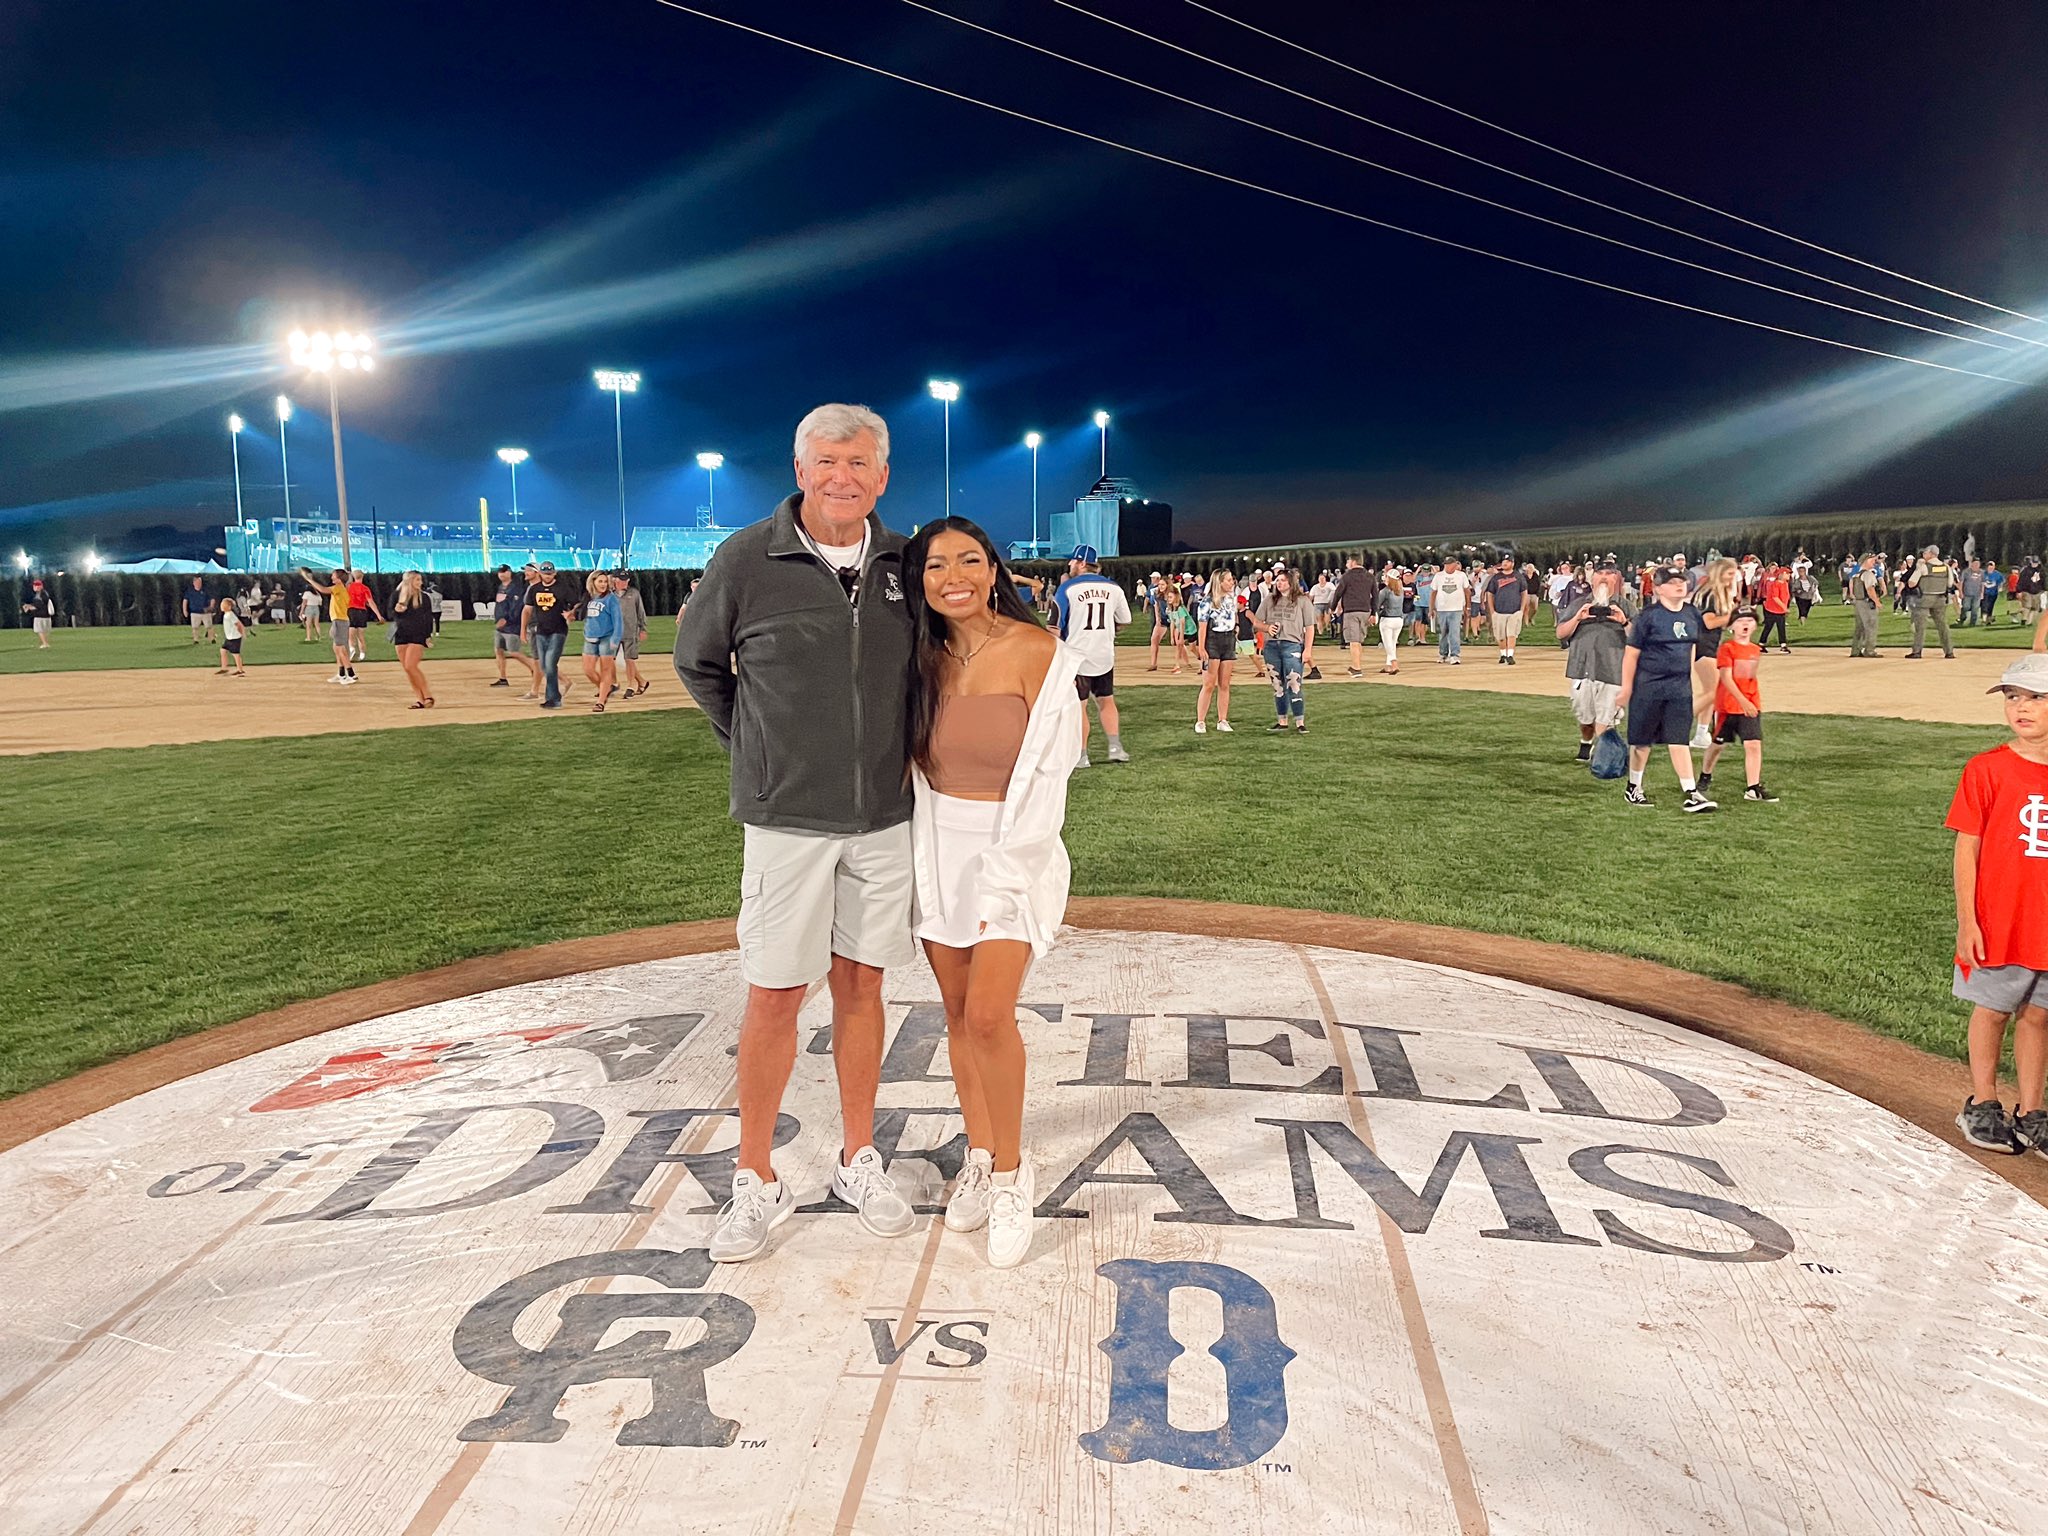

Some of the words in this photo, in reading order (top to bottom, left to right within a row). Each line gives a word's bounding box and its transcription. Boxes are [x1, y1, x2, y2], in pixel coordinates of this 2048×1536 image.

[1078, 590, 1110, 602] OHTANI
[1083, 603, 1105, 630] 11
[876, 1000, 1728, 1128] FIELD
[261, 1101, 1796, 1263] DREAMS
[1077, 1258, 1297, 1470] D
[1261, 1463, 1292, 1472] TM
